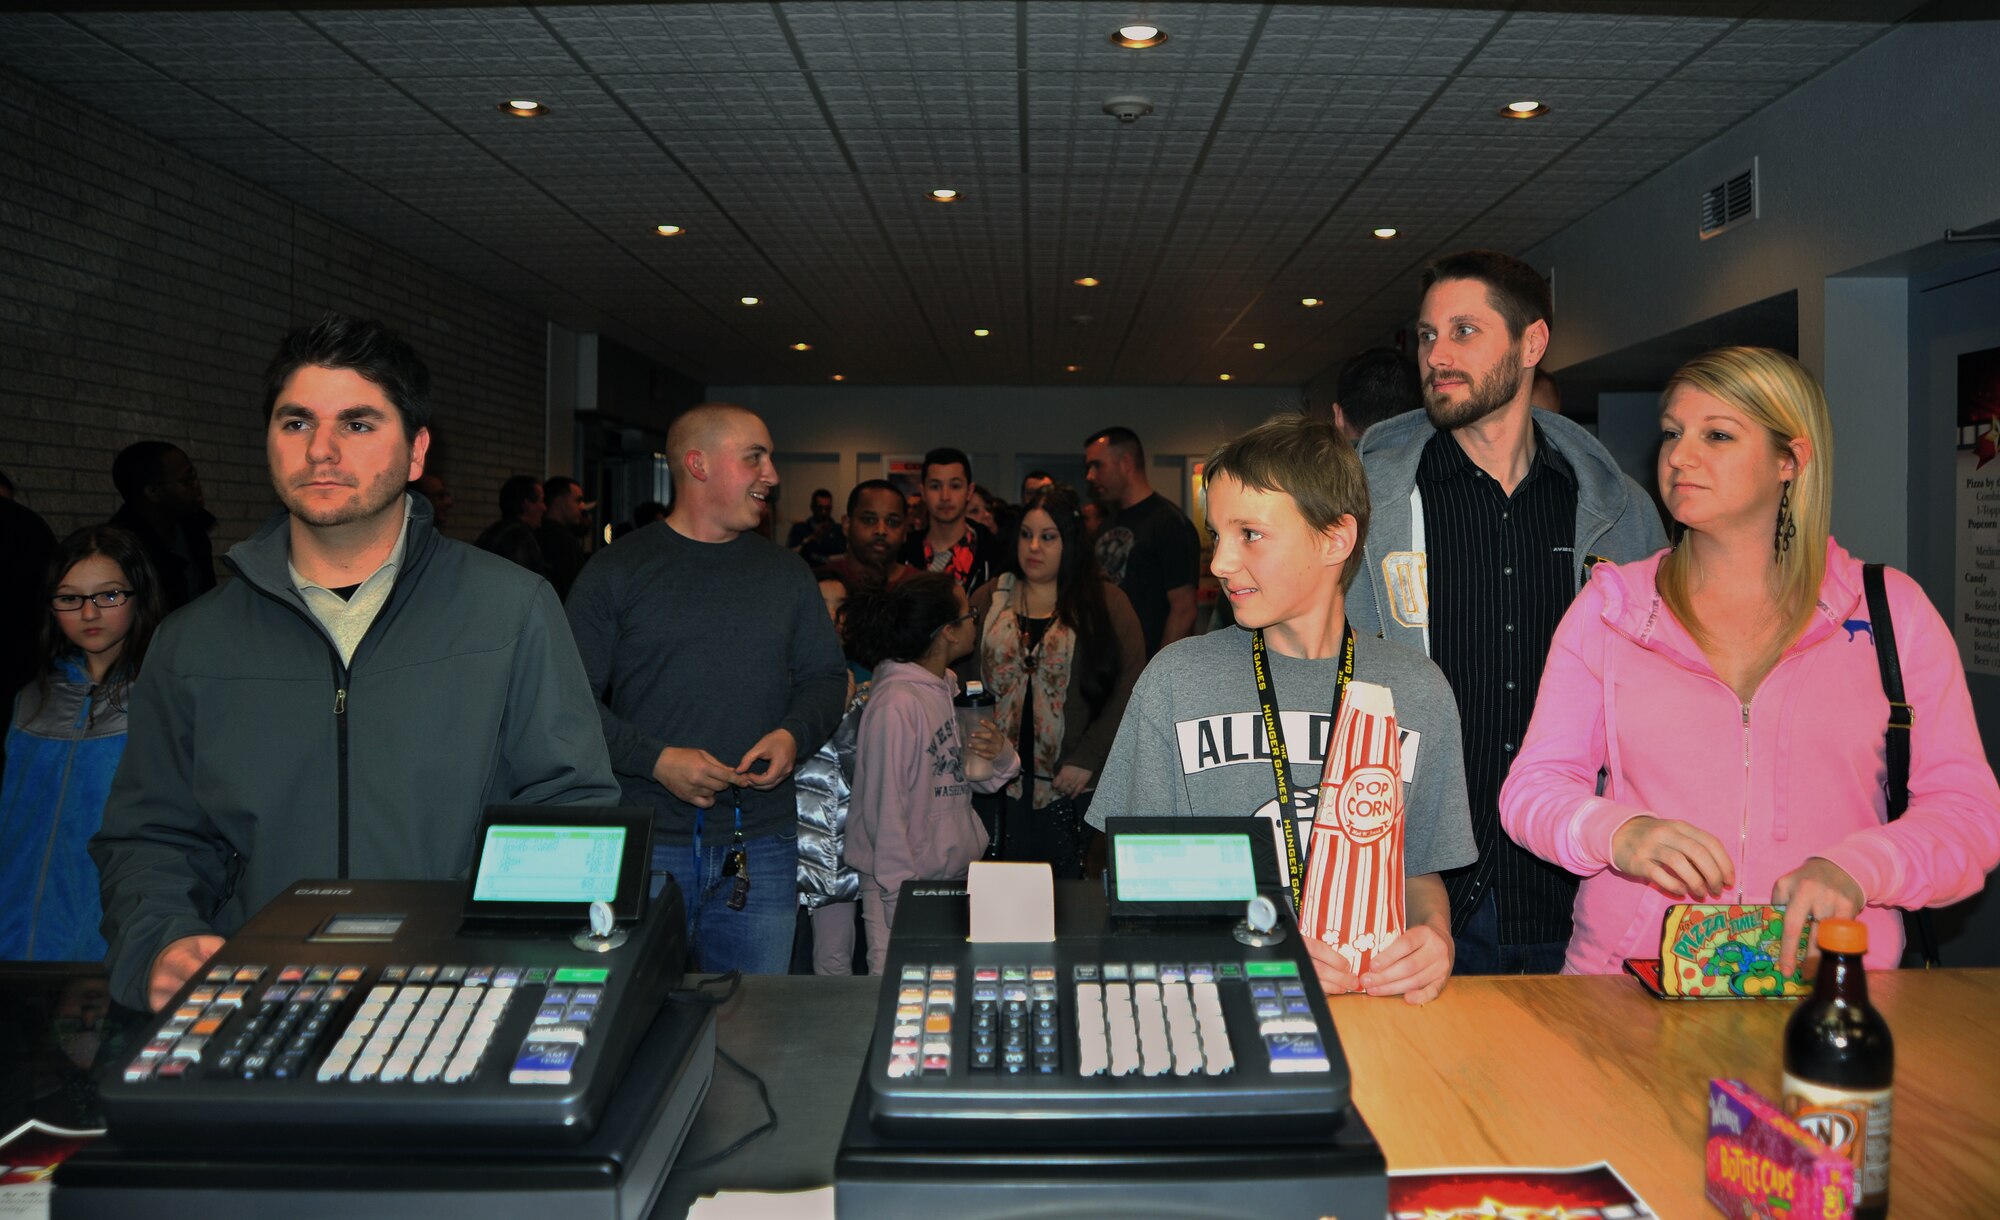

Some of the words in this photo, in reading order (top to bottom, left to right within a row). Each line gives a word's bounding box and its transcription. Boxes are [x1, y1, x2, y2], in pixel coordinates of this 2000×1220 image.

[1966, 479, 1984, 488] Pizza
[1986, 477, 1994, 490] by
[1968, 519, 1998, 529] Popcorn
[1965, 573, 1987, 587] Candy
[1254, 652, 1267, 690] GAMES
[1263, 703, 1281, 756] HUNGER
[1274, 758, 1289, 805] GAMES
[1280, 743, 1288, 760] THE
[1355, 781, 1389, 797] POP
[1347, 797, 1393, 817] CORN
[1283, 819, 1299, 876] HUNGER
[294, 888, 353, 896] CASIO
[912, 889, 968, 897] CASIO
[1672, 913, 1728, 963] PIZZA
